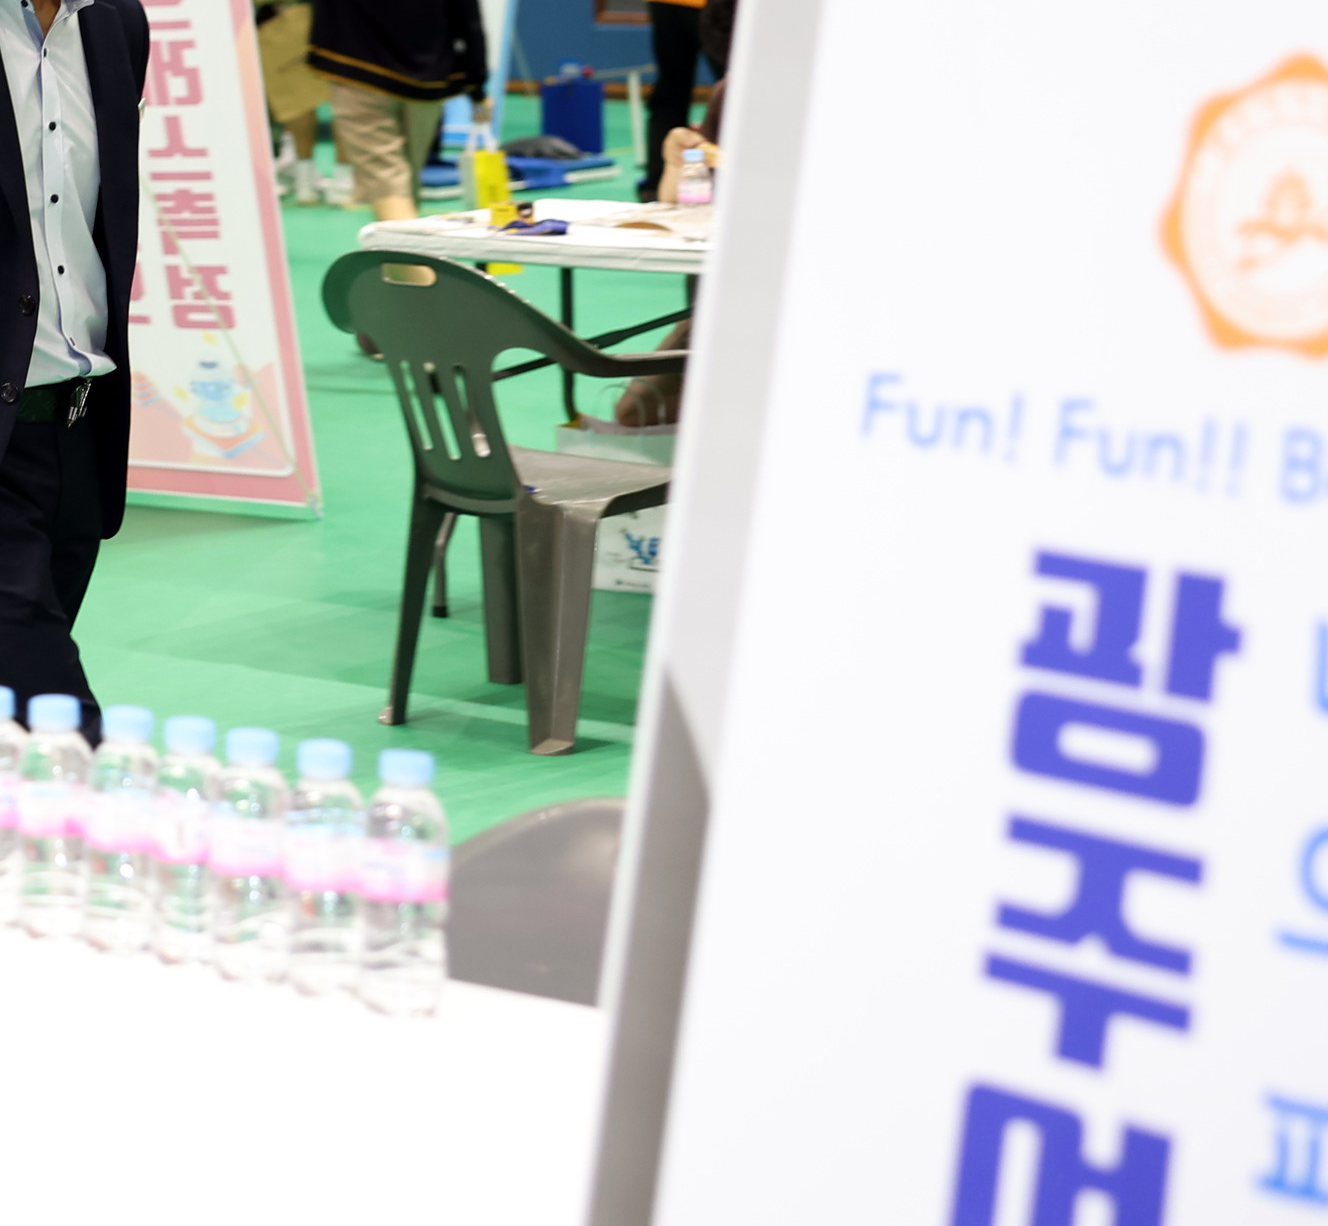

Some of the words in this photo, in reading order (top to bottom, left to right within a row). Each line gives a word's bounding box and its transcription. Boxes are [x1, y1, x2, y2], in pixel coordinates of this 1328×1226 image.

[860, 372, 1025, 464] Fun!
[1052, 396, 1250, 497] Fun!!
[1279, 425, 1328, 508] B
